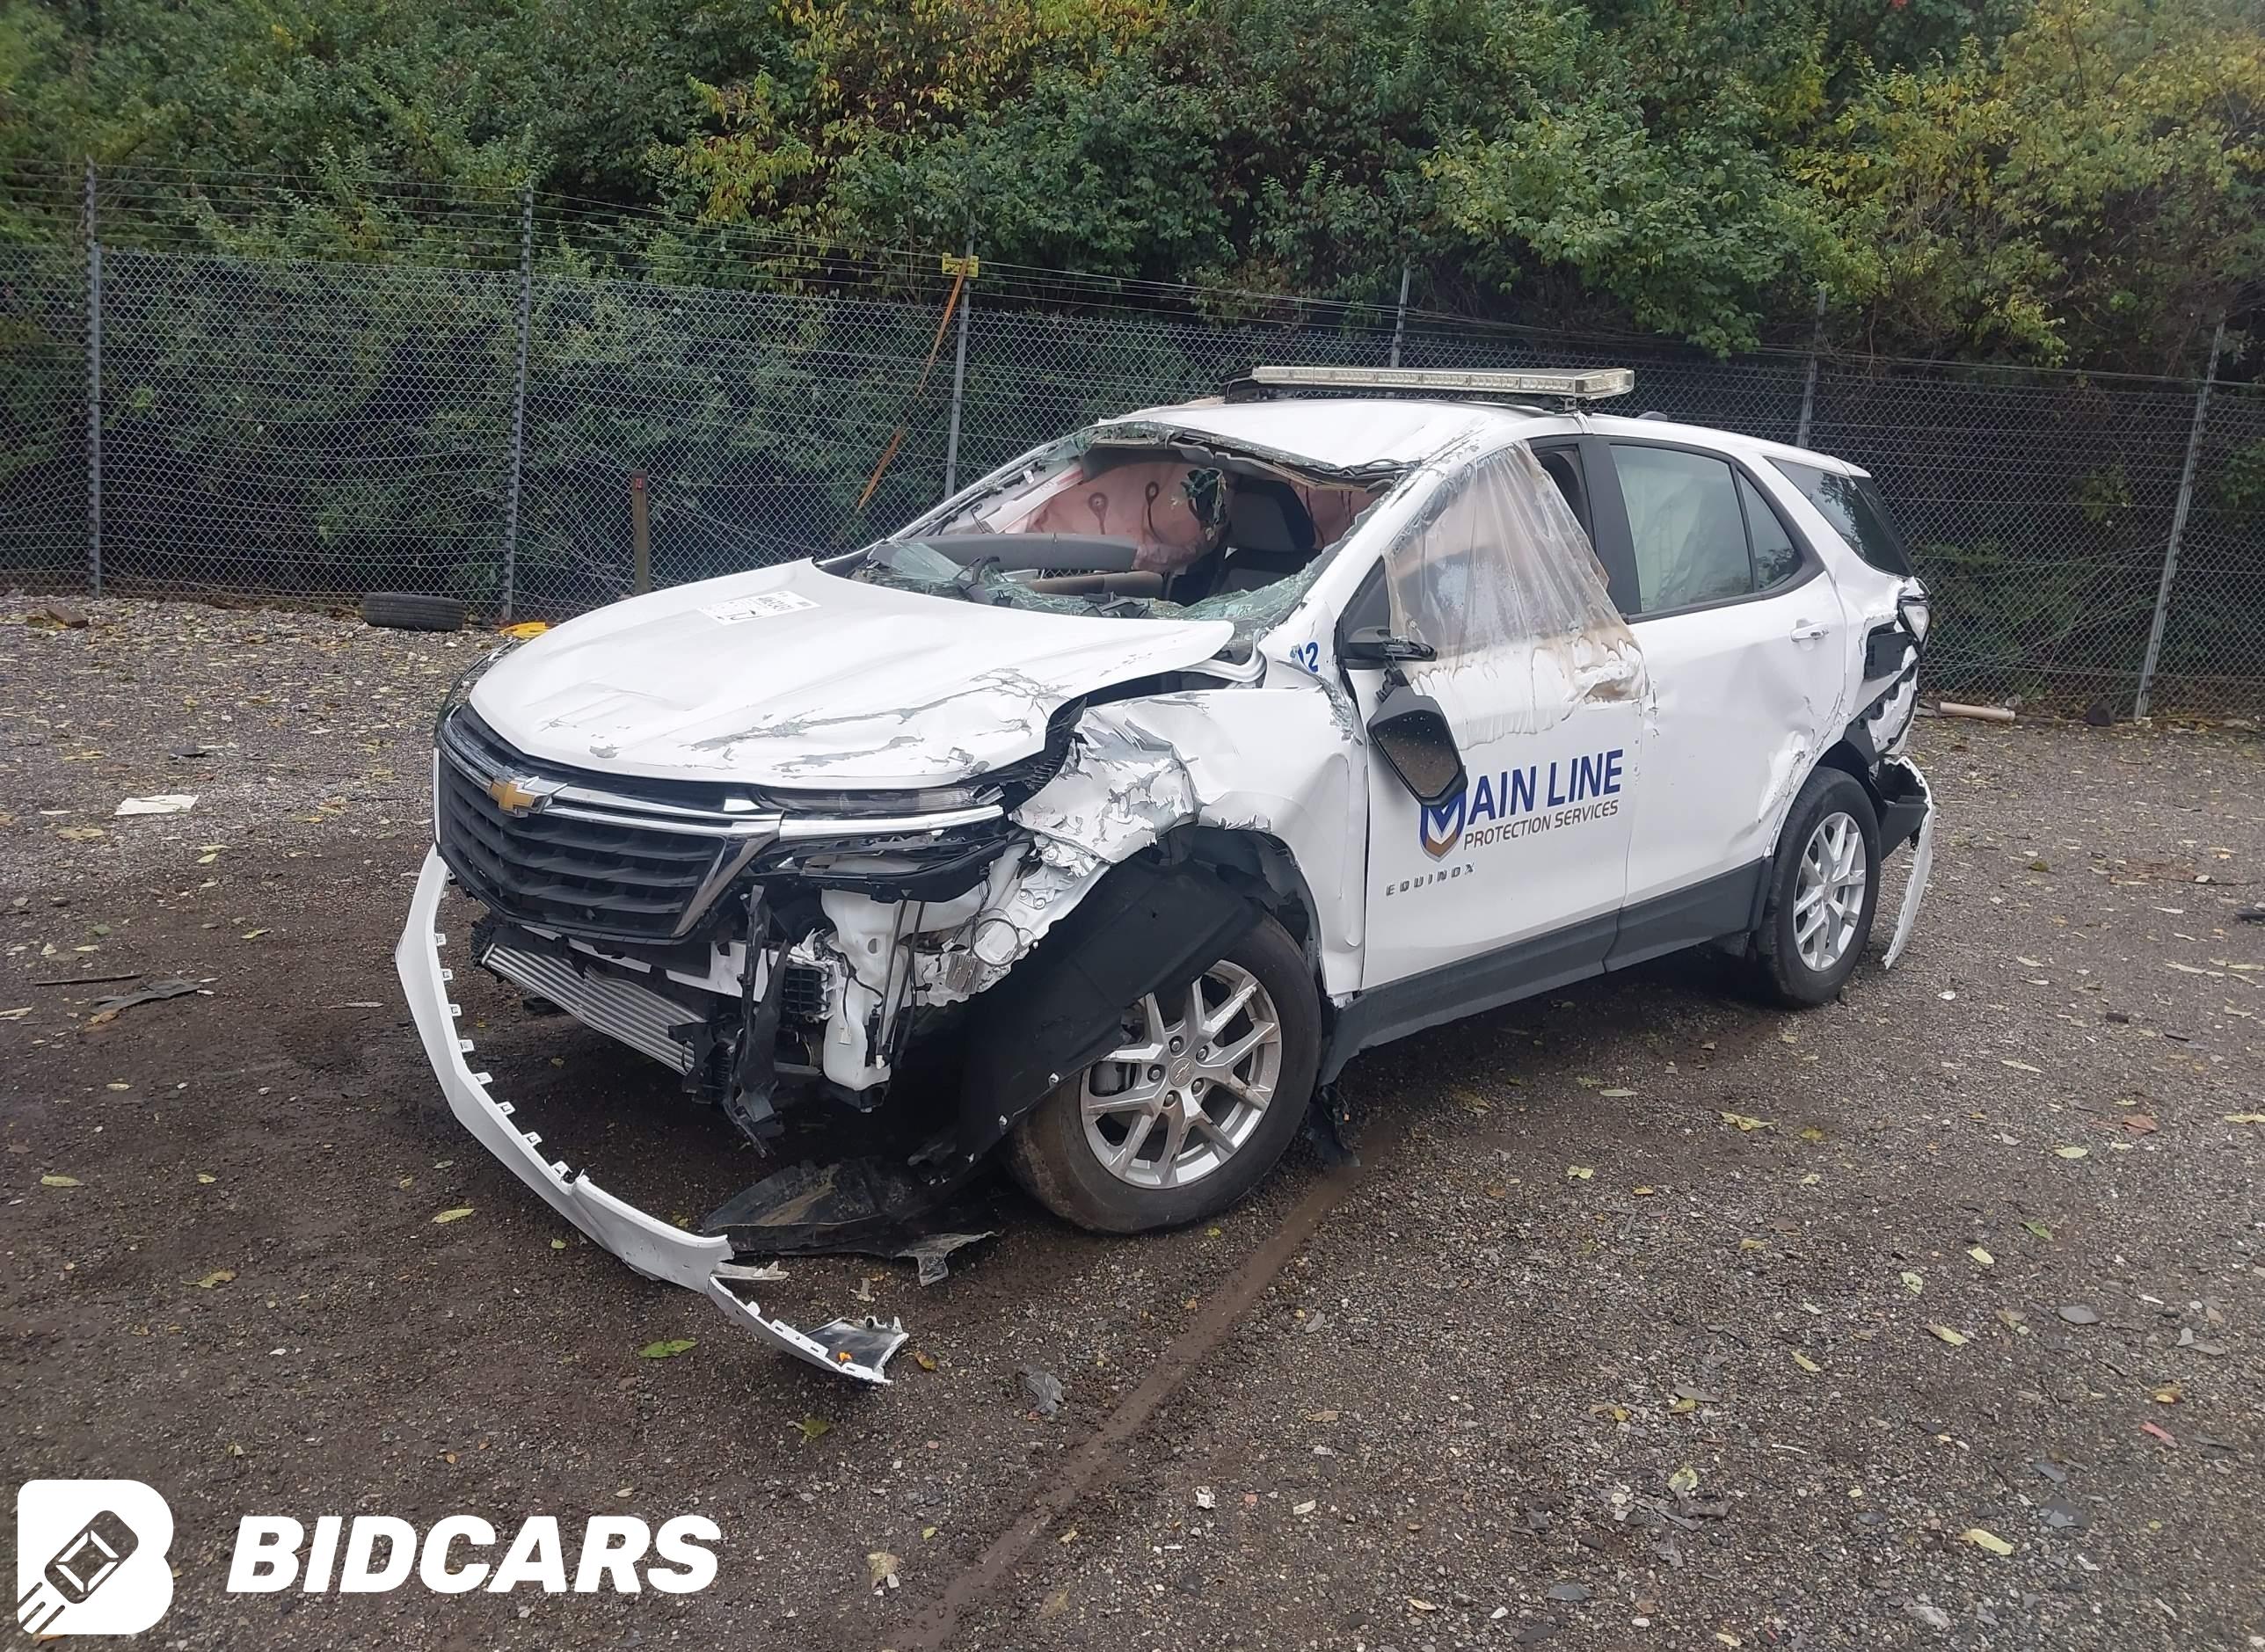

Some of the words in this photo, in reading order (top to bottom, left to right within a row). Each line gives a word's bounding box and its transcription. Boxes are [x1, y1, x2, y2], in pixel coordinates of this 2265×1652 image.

[1548, 749, 1624, 807] LINE
[1464, 814, 1551, 850] PROTECTION
[1555, 799, 1619, 829] SERVICES
[1386, 862, 1475, 896] EQUINOX
